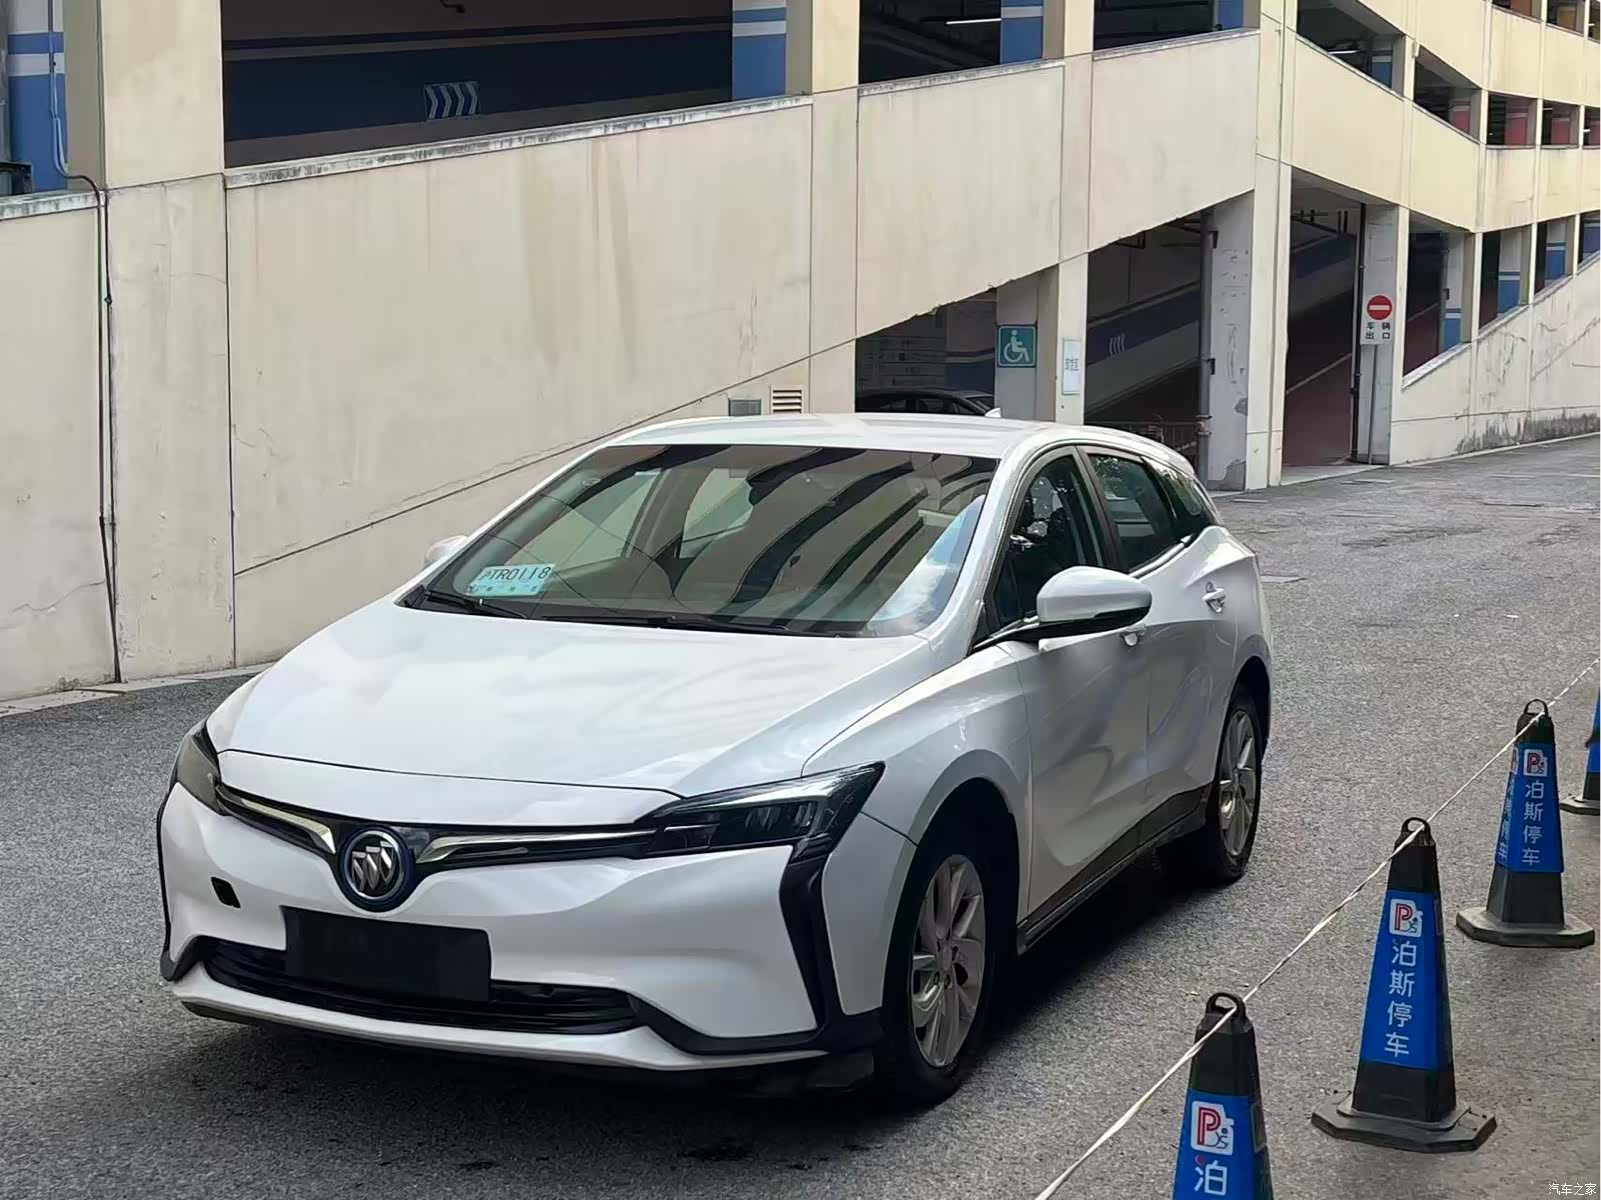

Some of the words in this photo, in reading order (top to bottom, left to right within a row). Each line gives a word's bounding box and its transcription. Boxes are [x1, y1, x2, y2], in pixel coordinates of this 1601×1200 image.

[1365, 321, 1391, 331] 车辆
[1365, 331, 1391, 340] 出口
[1521, 779, 1545, 867] 泊斯停车
[1383, 939, 1417, 1058] 泊斯停车
[1193, 1159, 1228, 1196] 泊
